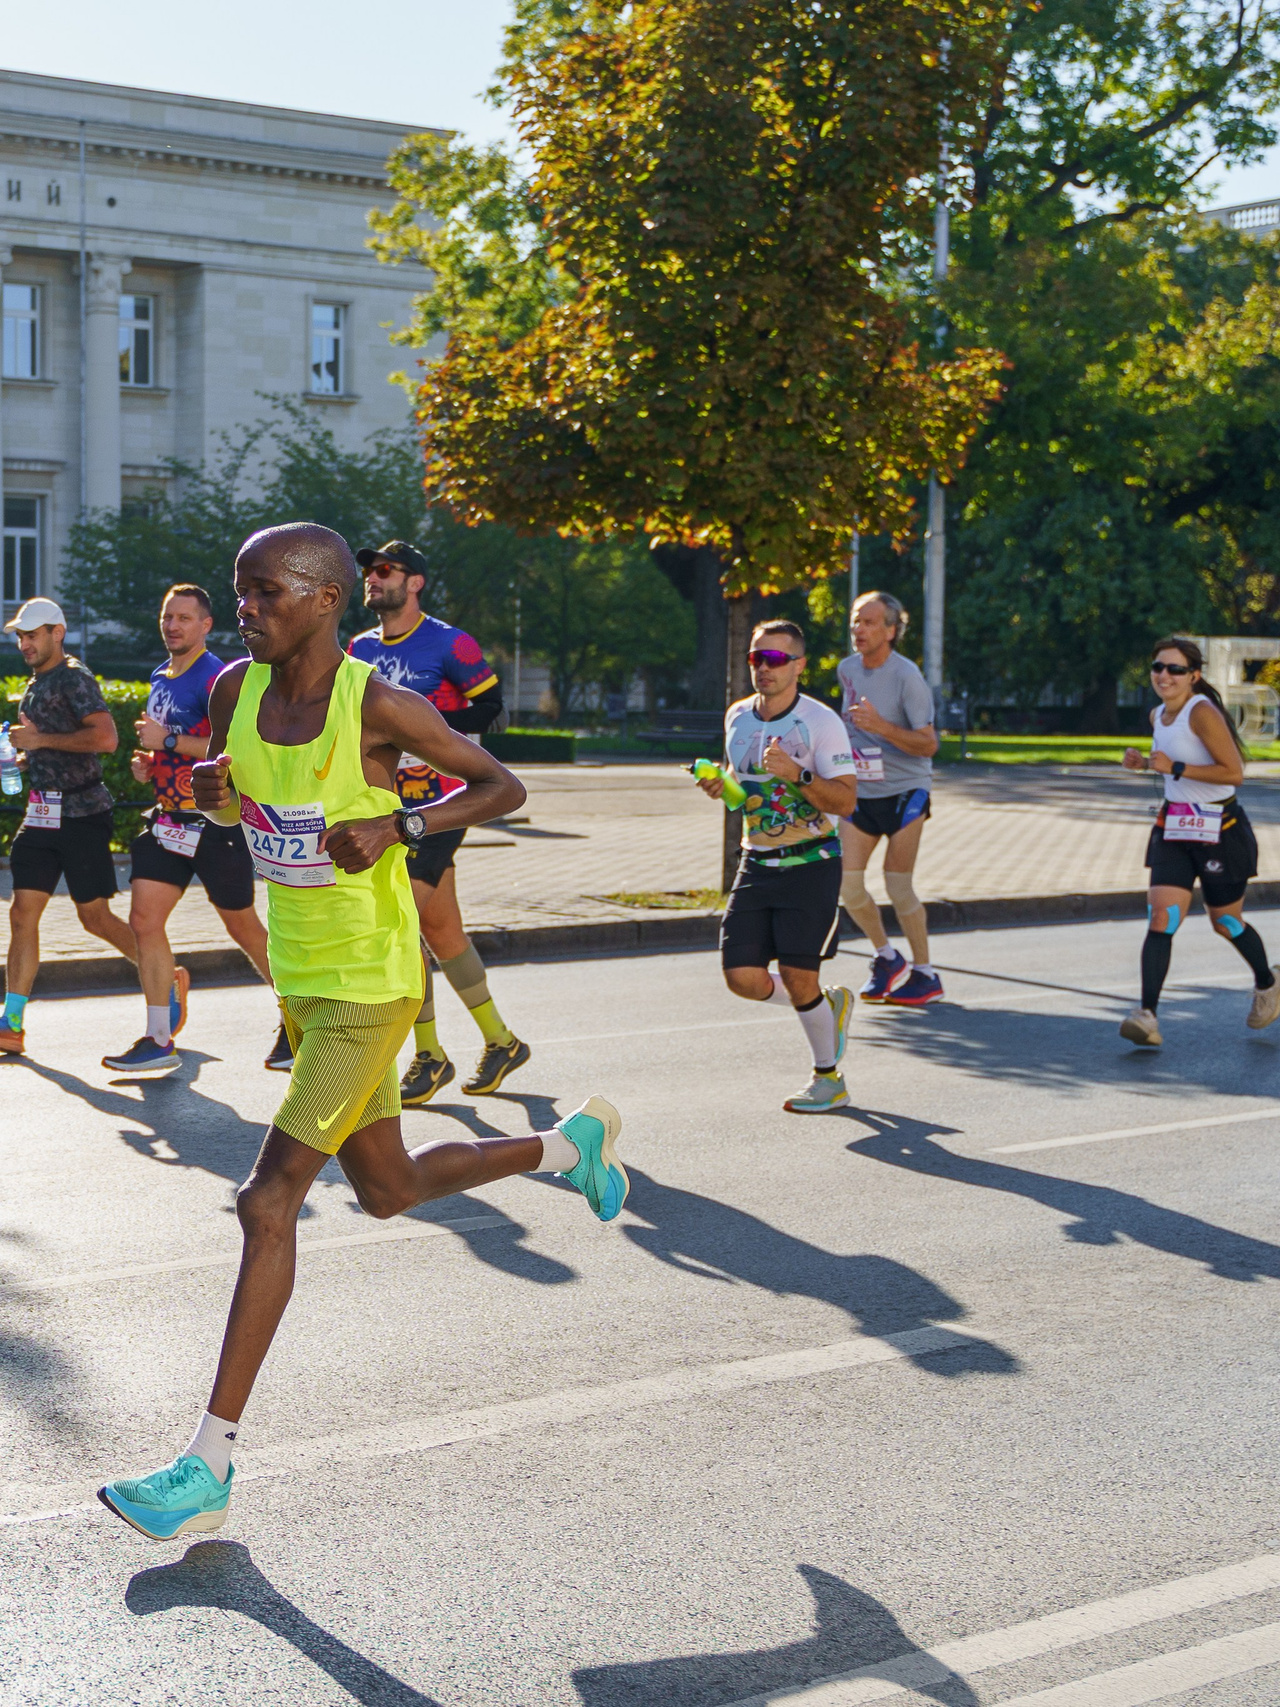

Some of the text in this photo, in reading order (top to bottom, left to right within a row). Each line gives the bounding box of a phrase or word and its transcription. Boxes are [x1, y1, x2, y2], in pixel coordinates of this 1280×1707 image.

[34, 805, 50, 816] 489
[1178, 817, 1205, 828] 648
[163, 828, 188, 840] 426
[250, 829, 307, 860] 2472
